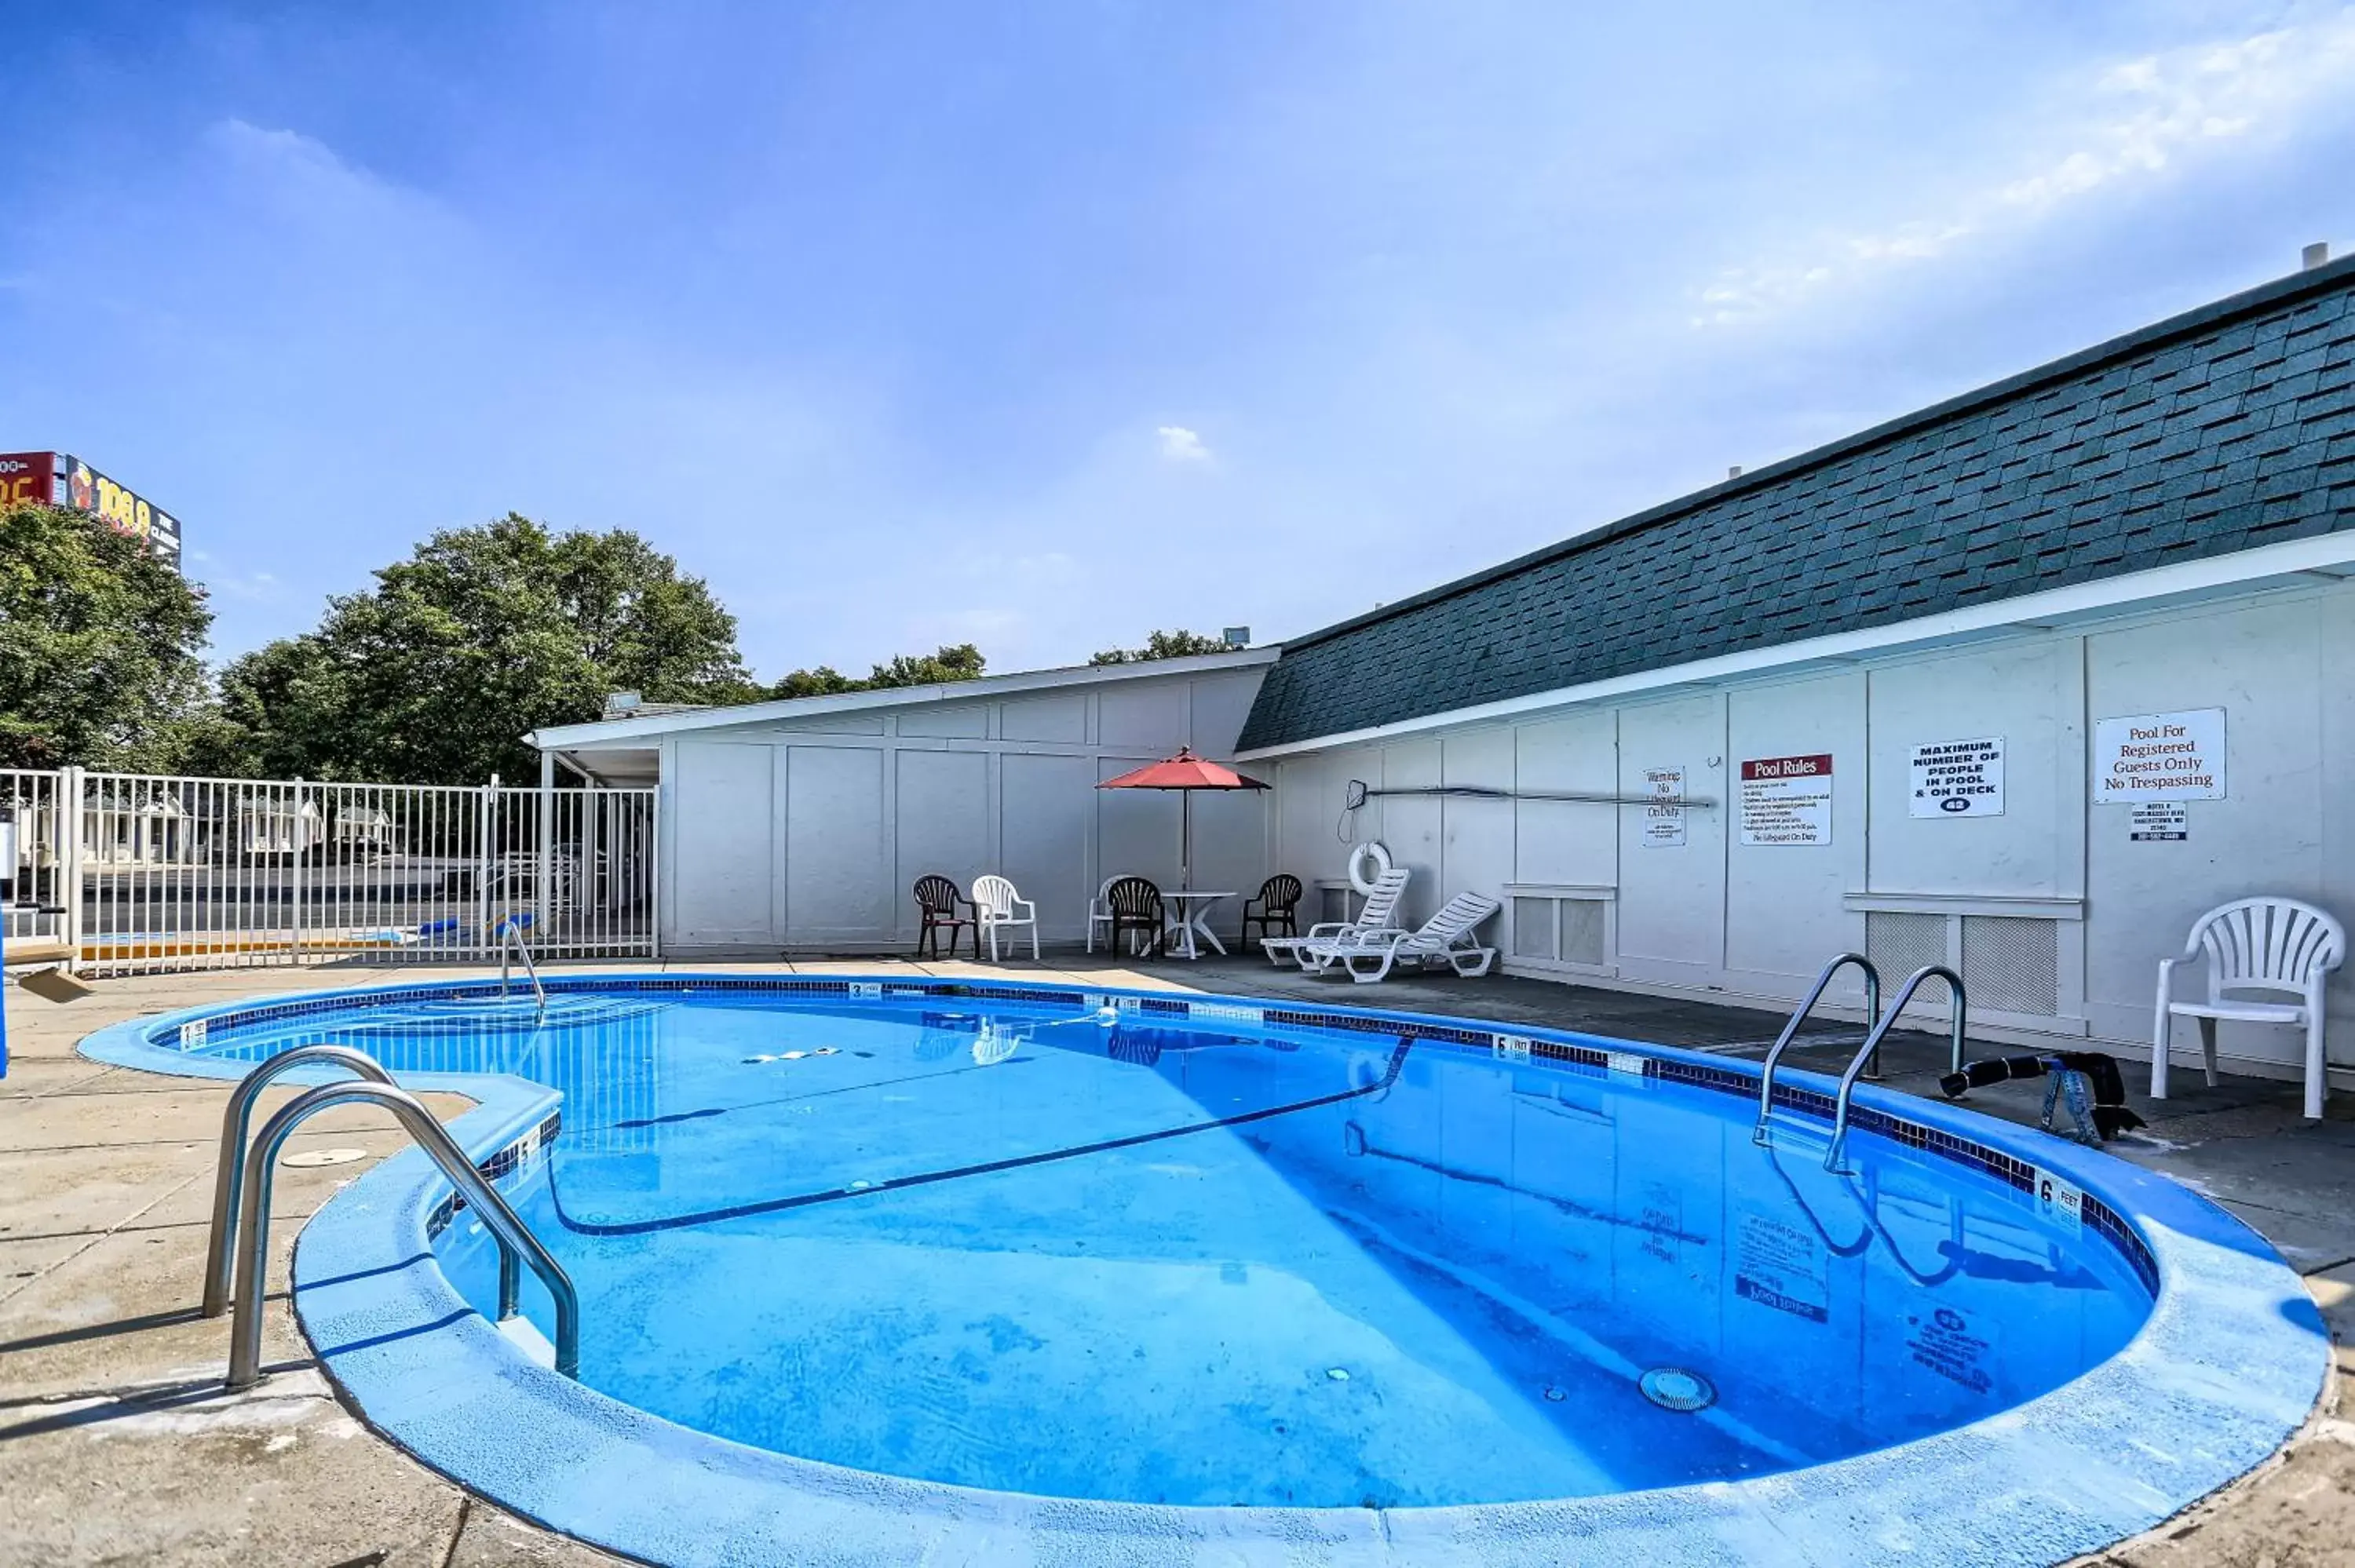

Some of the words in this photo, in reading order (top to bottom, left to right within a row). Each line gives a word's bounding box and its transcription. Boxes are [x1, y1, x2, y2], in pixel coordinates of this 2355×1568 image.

[2129, 727, 2159, 740] Pool
[2163, 724, 2186, 738] For
[1920, 742, 1992, 756] MAXIMUM
[2120, 740, 2195, 758] Registered
[1754, 762, 1780, 777] Pool
[1783, 759, 1817, 775] Rules
[1913, 754, 1973, 767] NUMBER
[2113, 761, 2161, 774] Guests
[2164, 757, 2202, 771] Only
[1928, 764, 1984, 775] PEOPLE
[1658, 782, 1670, 793] No
[1926, 778, 1940, 786] IN
[1945, 775, 1985, 786] POOL
[2105, 778, 2125, 790] No
[2128, 773, 2213, 790] Trespassing
[1930, 787, 1951, 796] ON
[1956, 785, 1996, 795] DECK
[2041, 1180, 2053, 1202] 6
[2061, 1190, 2078, 1206] FEET
